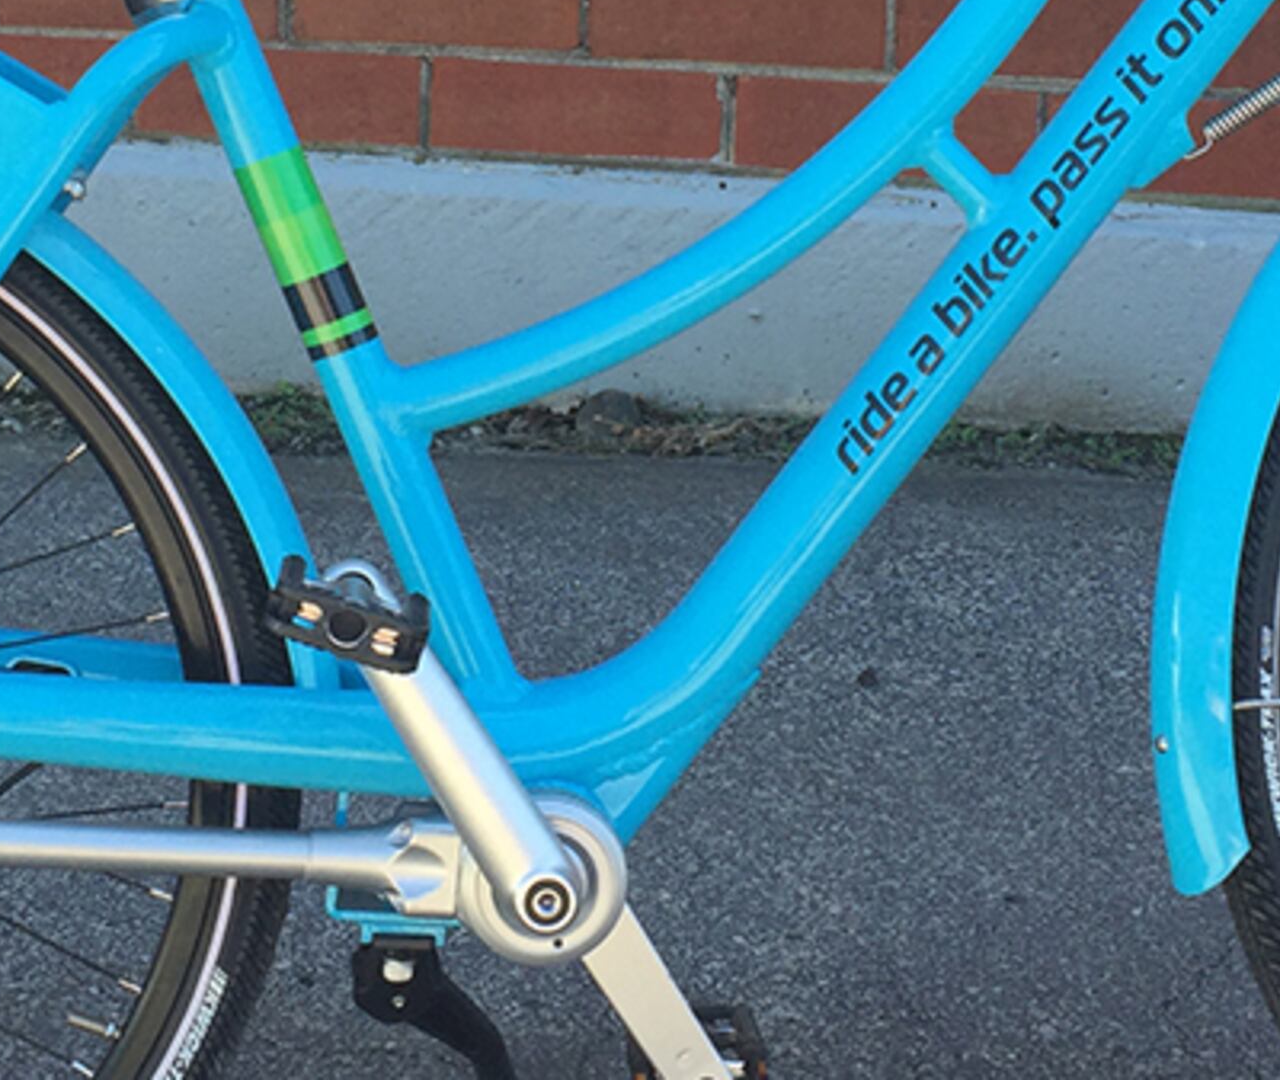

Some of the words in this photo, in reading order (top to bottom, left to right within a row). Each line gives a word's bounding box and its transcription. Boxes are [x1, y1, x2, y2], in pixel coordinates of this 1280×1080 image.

[837, 371, 917, 476] ride
[909, 335, 946, 376] a
[933, 227, 1039, 338] bike.
[1030, 95, 1130, 230] pass
[1116, 51, 1164, 104] it
